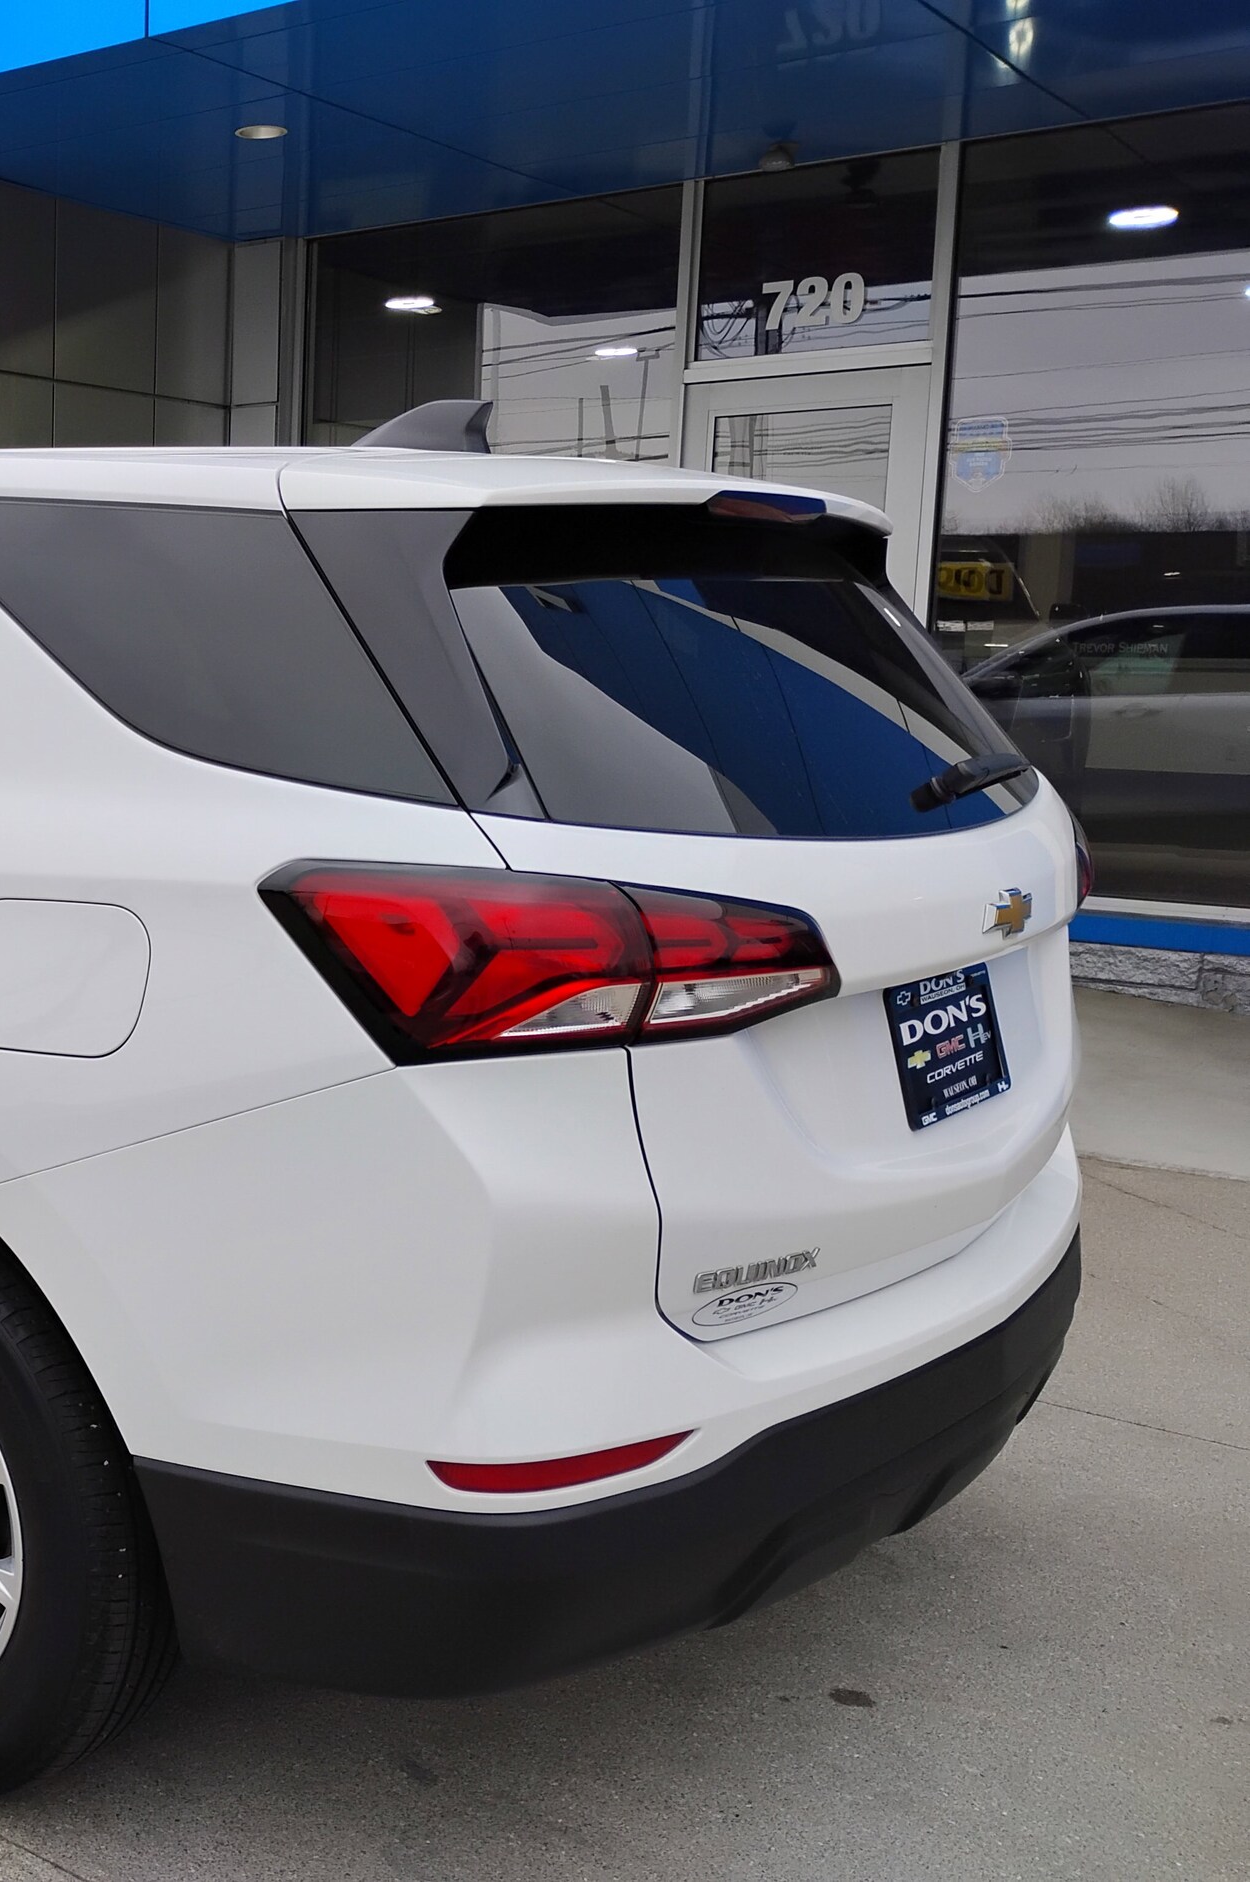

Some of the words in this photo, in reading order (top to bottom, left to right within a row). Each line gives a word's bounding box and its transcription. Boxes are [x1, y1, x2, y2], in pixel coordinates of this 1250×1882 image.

[762, 272, 865, 331] 720
[1072, 641, 1115, 654] TREVOR
[899, 994, 987, 1046] DON'S
[936, 1034, 966, 1059] GMC
[926, 1050, 984, 1084] CORVETTE
[693, 1246, 821, 1294] EQUINOX
[716, 1285, 784, 1307] DON'S
